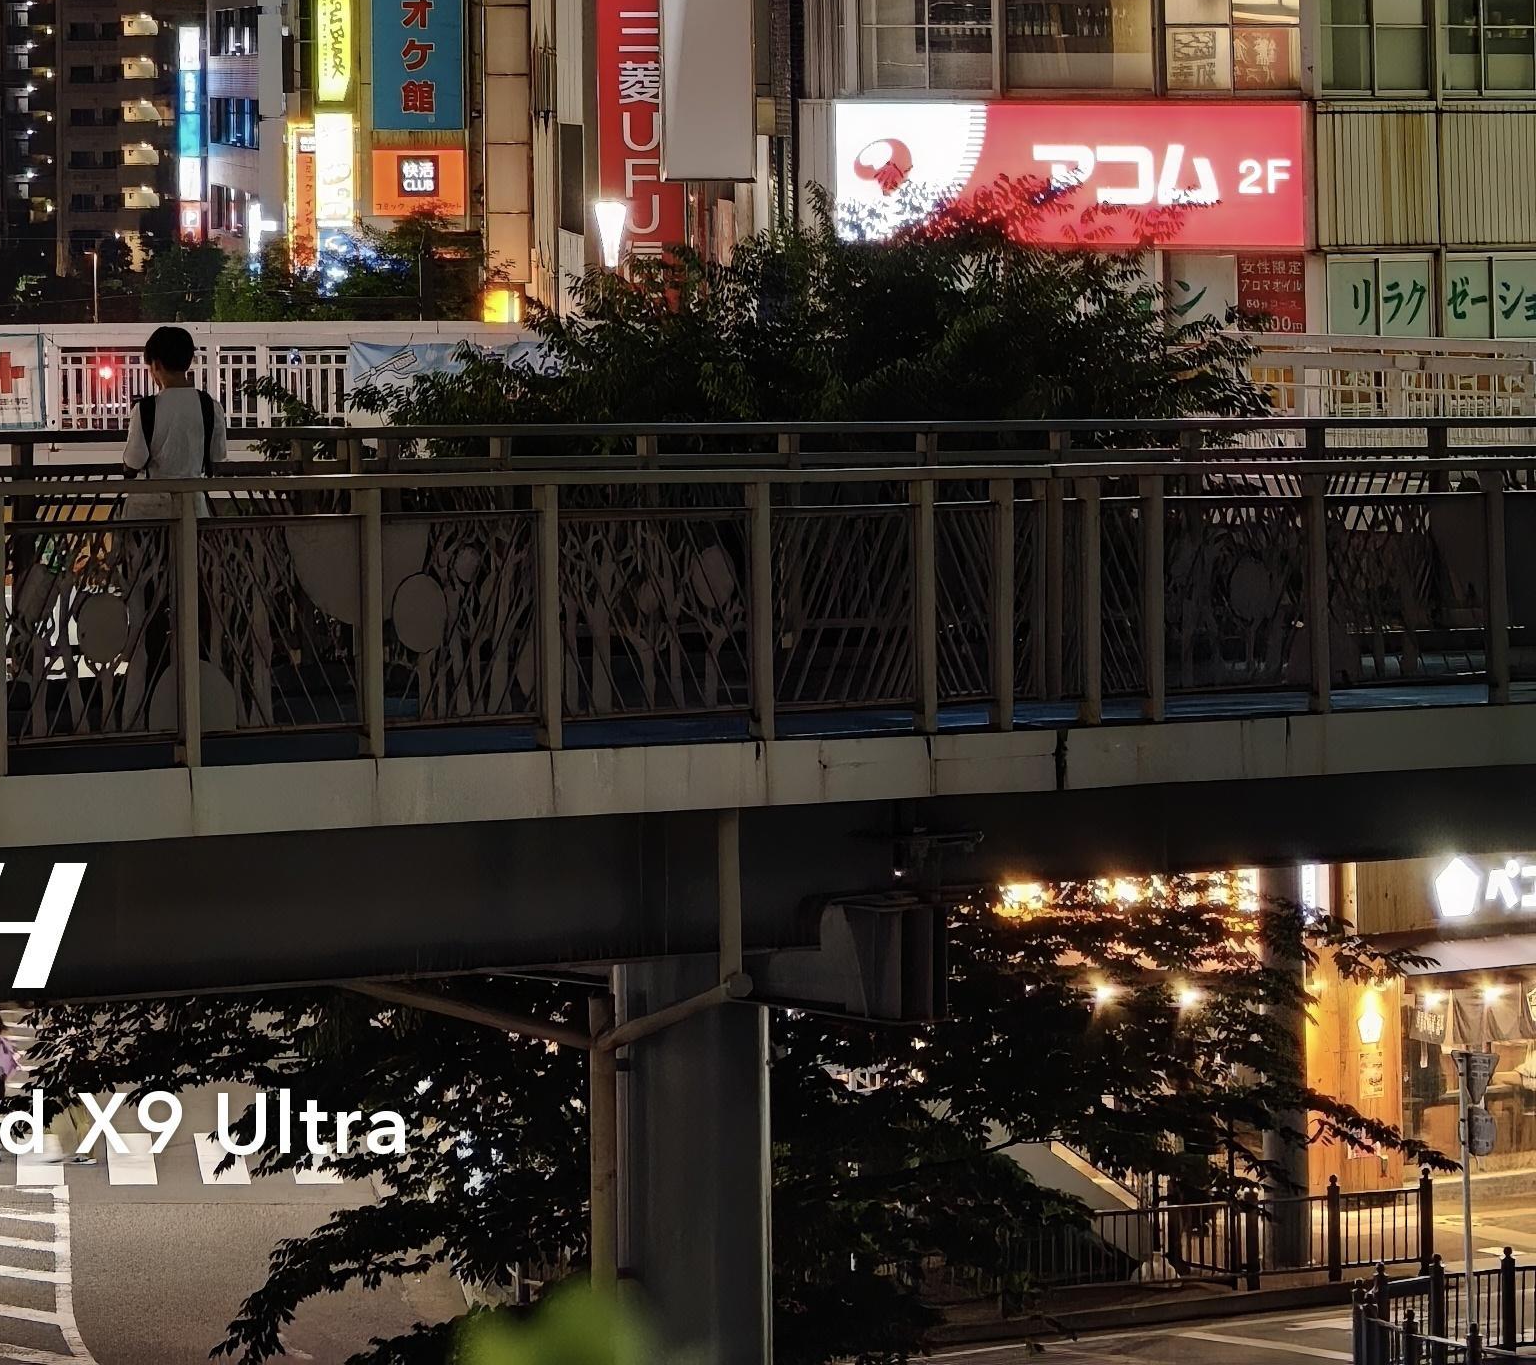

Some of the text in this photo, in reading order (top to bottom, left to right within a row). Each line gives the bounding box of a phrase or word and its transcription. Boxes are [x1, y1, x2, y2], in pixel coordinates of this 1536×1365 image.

[402, 160, 435, 178] 快活
[1032, 143, 1292, 206] アコム 2F
[402, 179, 435, 192] CLUB
[1241, 260, 1303, 275] 女性限定
[1241, 278, 1302, 292] アロマオイル
